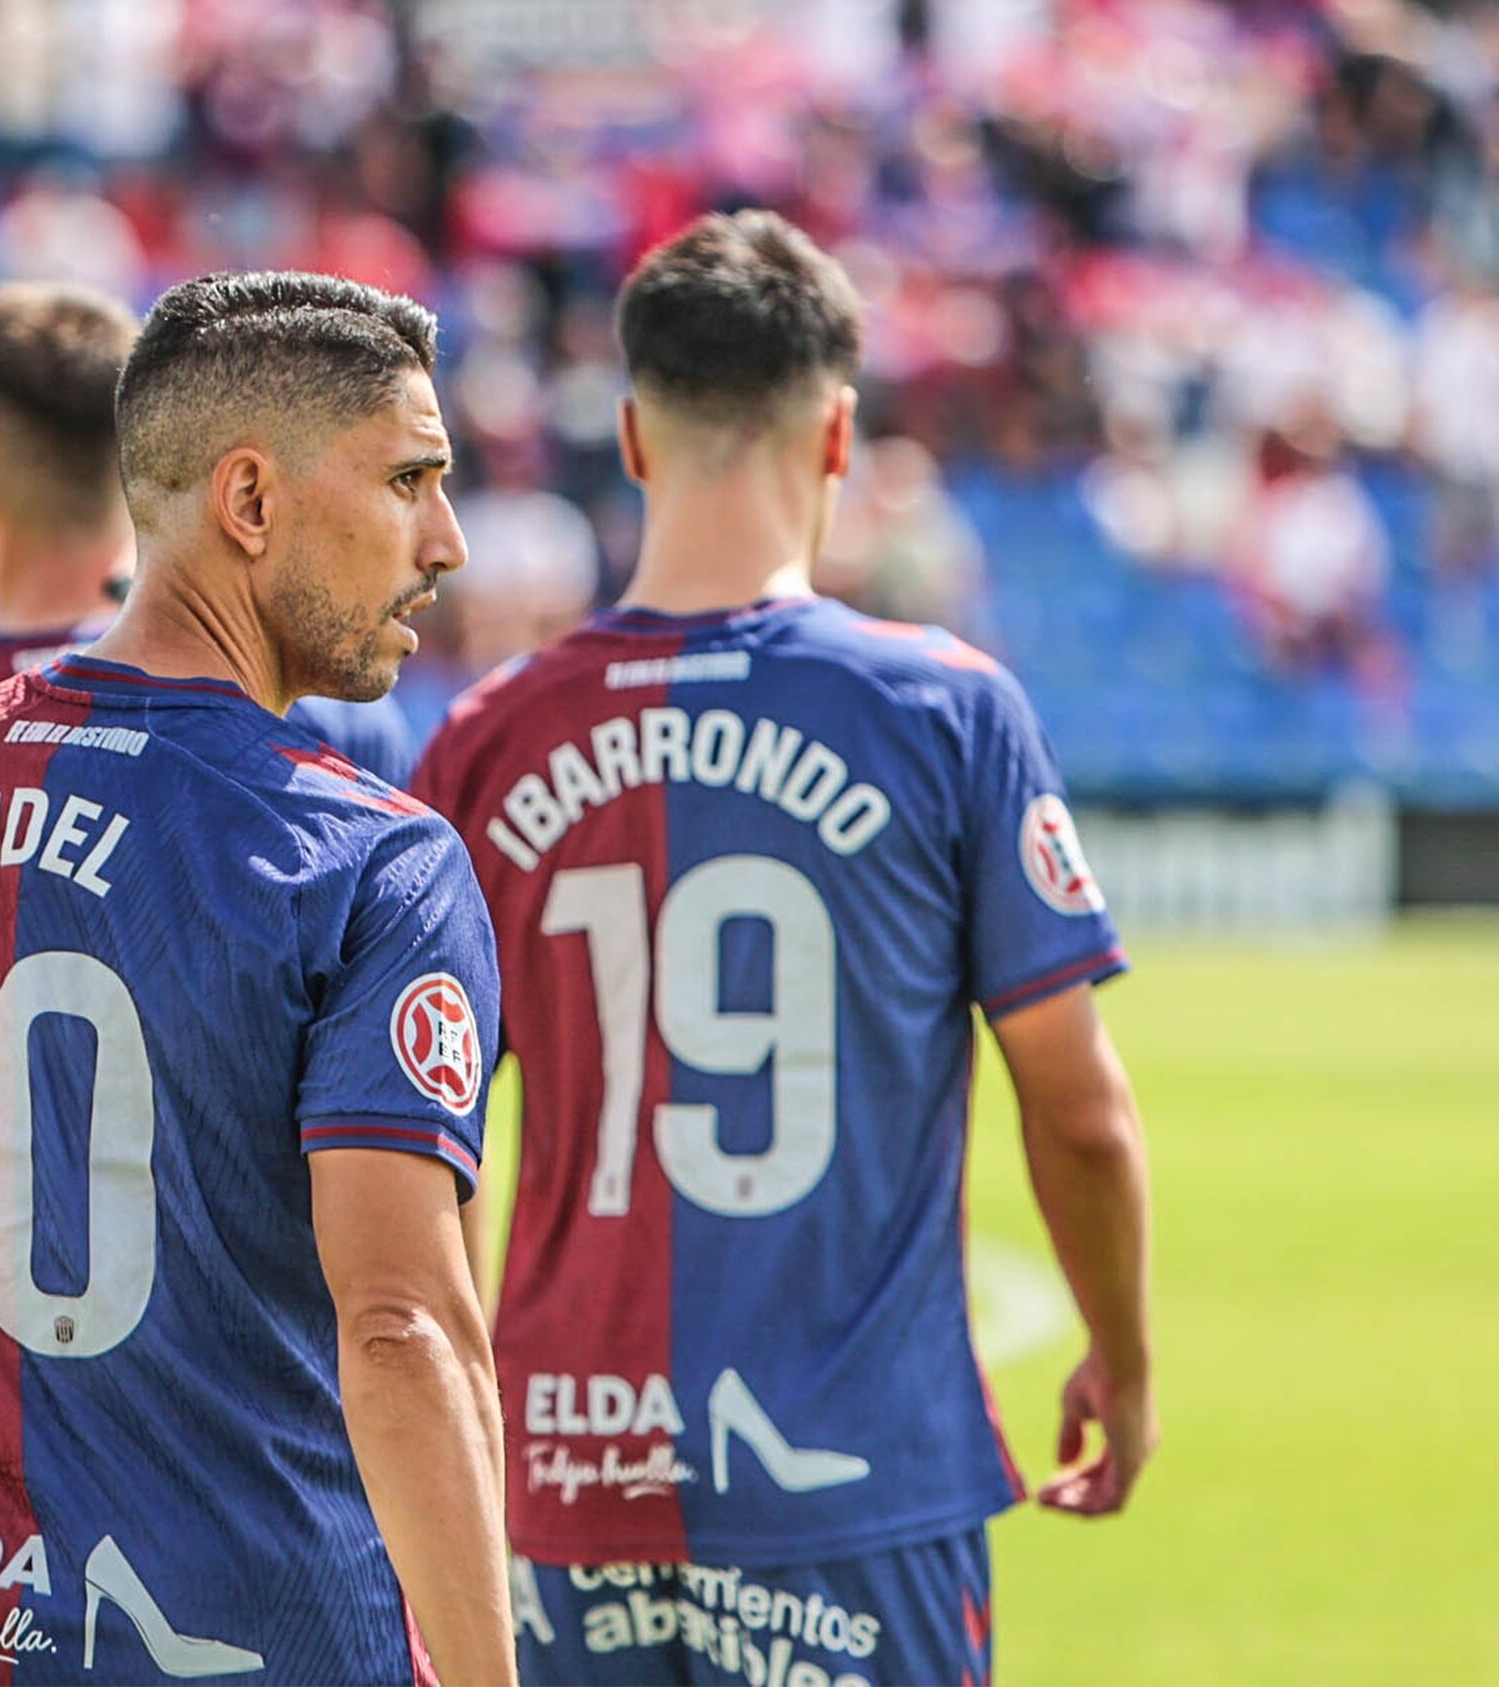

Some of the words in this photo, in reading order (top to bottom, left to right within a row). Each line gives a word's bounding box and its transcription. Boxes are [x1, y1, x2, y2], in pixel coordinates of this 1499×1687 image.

[487, 707, 891, 874] IBARRONDO
[540, 853, 838, 1218] 19
[525, 1373, 685, 1436] ELDA
